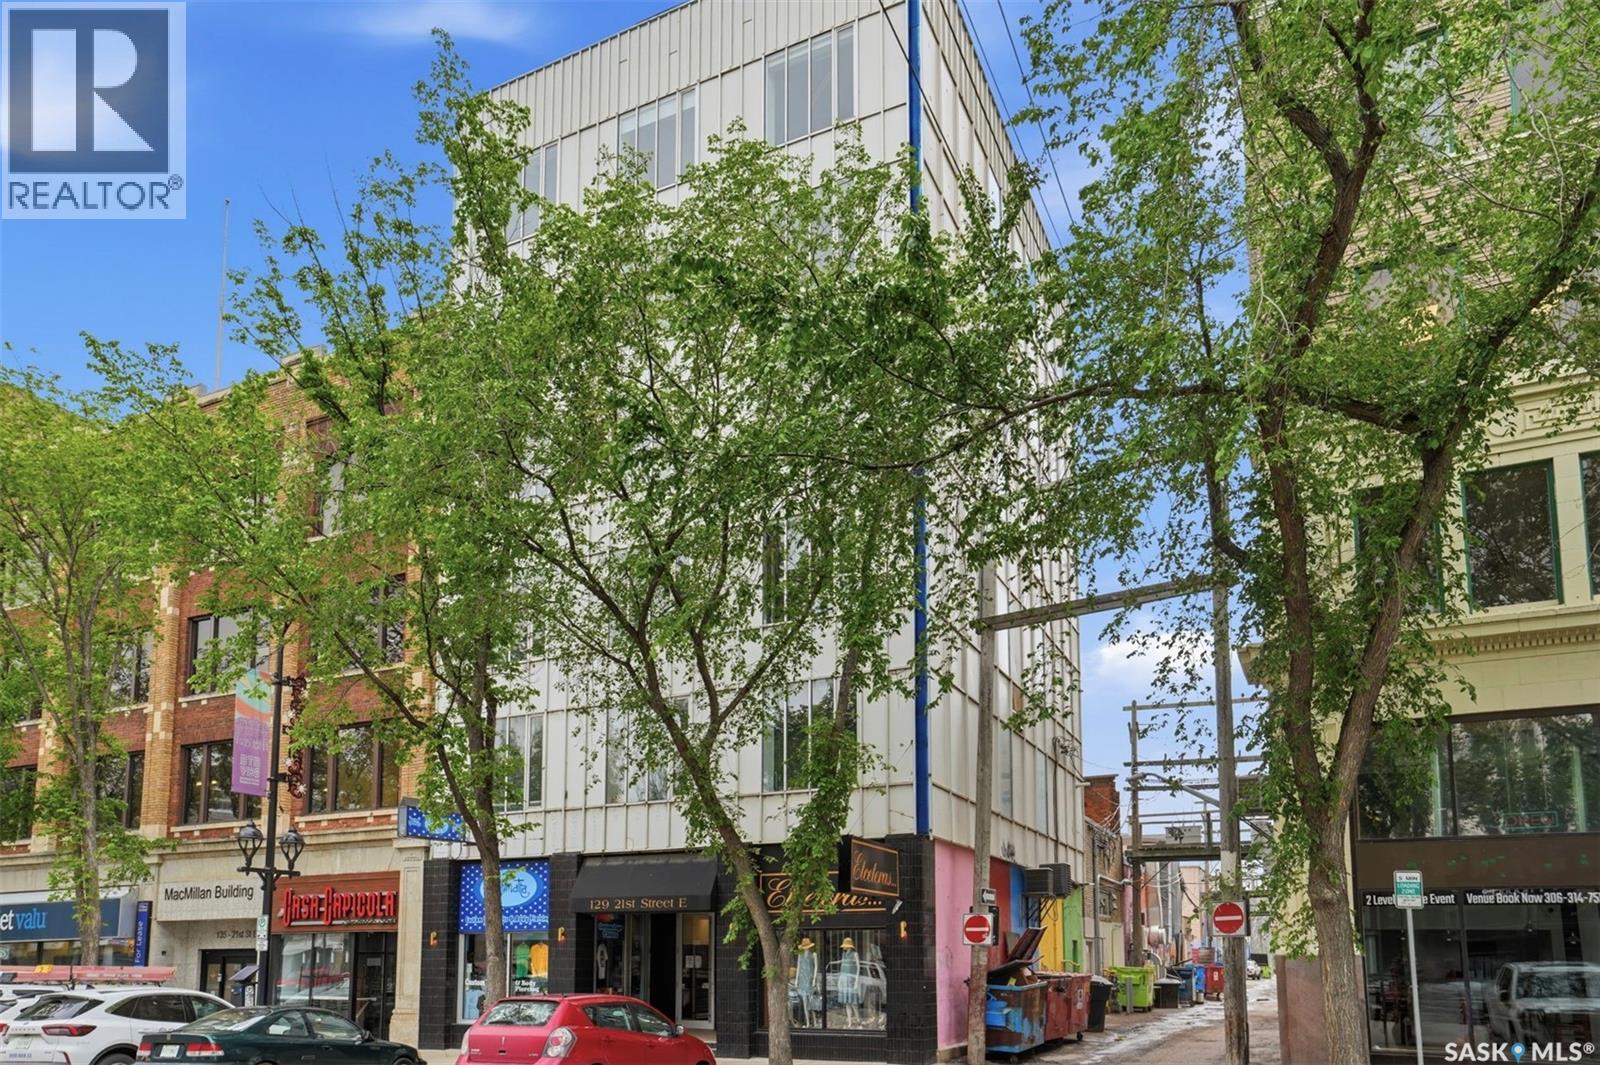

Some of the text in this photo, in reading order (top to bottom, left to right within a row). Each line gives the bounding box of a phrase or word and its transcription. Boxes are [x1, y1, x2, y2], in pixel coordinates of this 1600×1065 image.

[164, 884, 254, 901] MacMillan Building
[1429, 893, 1456, 905] Event
[1466, 892, 1496, 904] Venue
[1496, 892, 1521, 904] Book
[1521, 892, 1543, 904] Now
[590, 897, 689, 910] 129 21st Street E
[1365, 894, 1372, 906] 2
[1373, 894, 1397, 905] Level
[15, 907, 48, 930] valu
[136, 920, 144, 946] Lease
